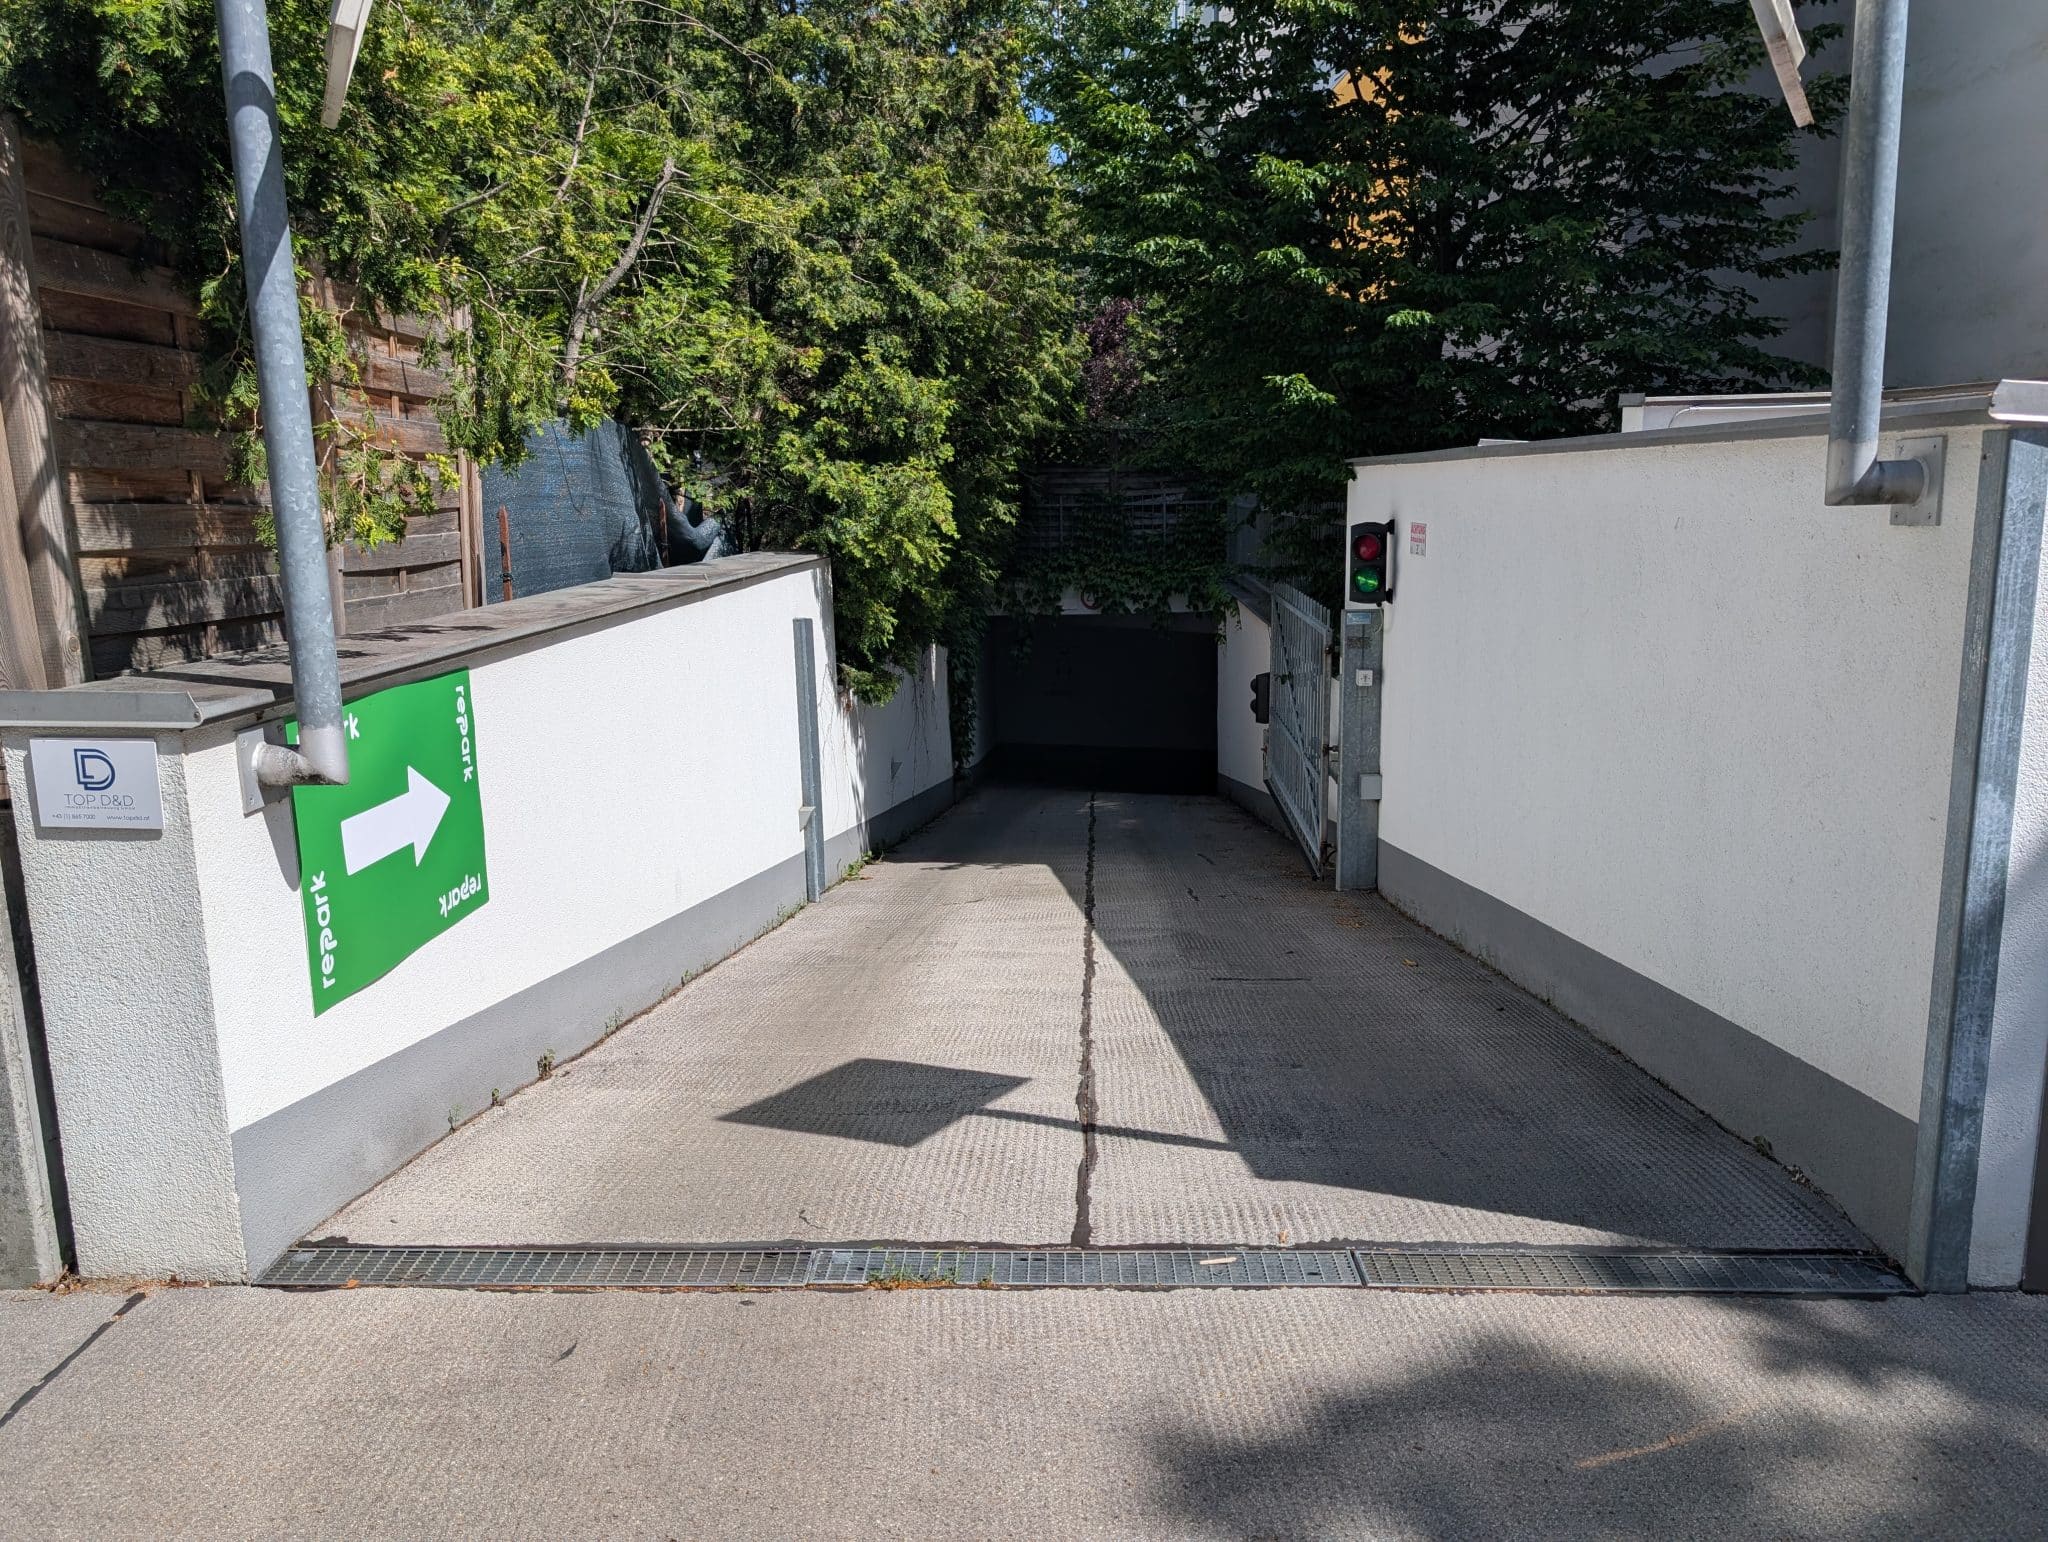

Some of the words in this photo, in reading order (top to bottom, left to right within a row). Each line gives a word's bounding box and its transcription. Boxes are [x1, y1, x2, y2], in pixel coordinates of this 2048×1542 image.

[455, 685, 473, 782] repark
[64, 793, 96, 806] TOP
[101, 794, 134, 807] D&D
[310, 870, 337, 989] repark
[439, 872, 482, 918] repark
